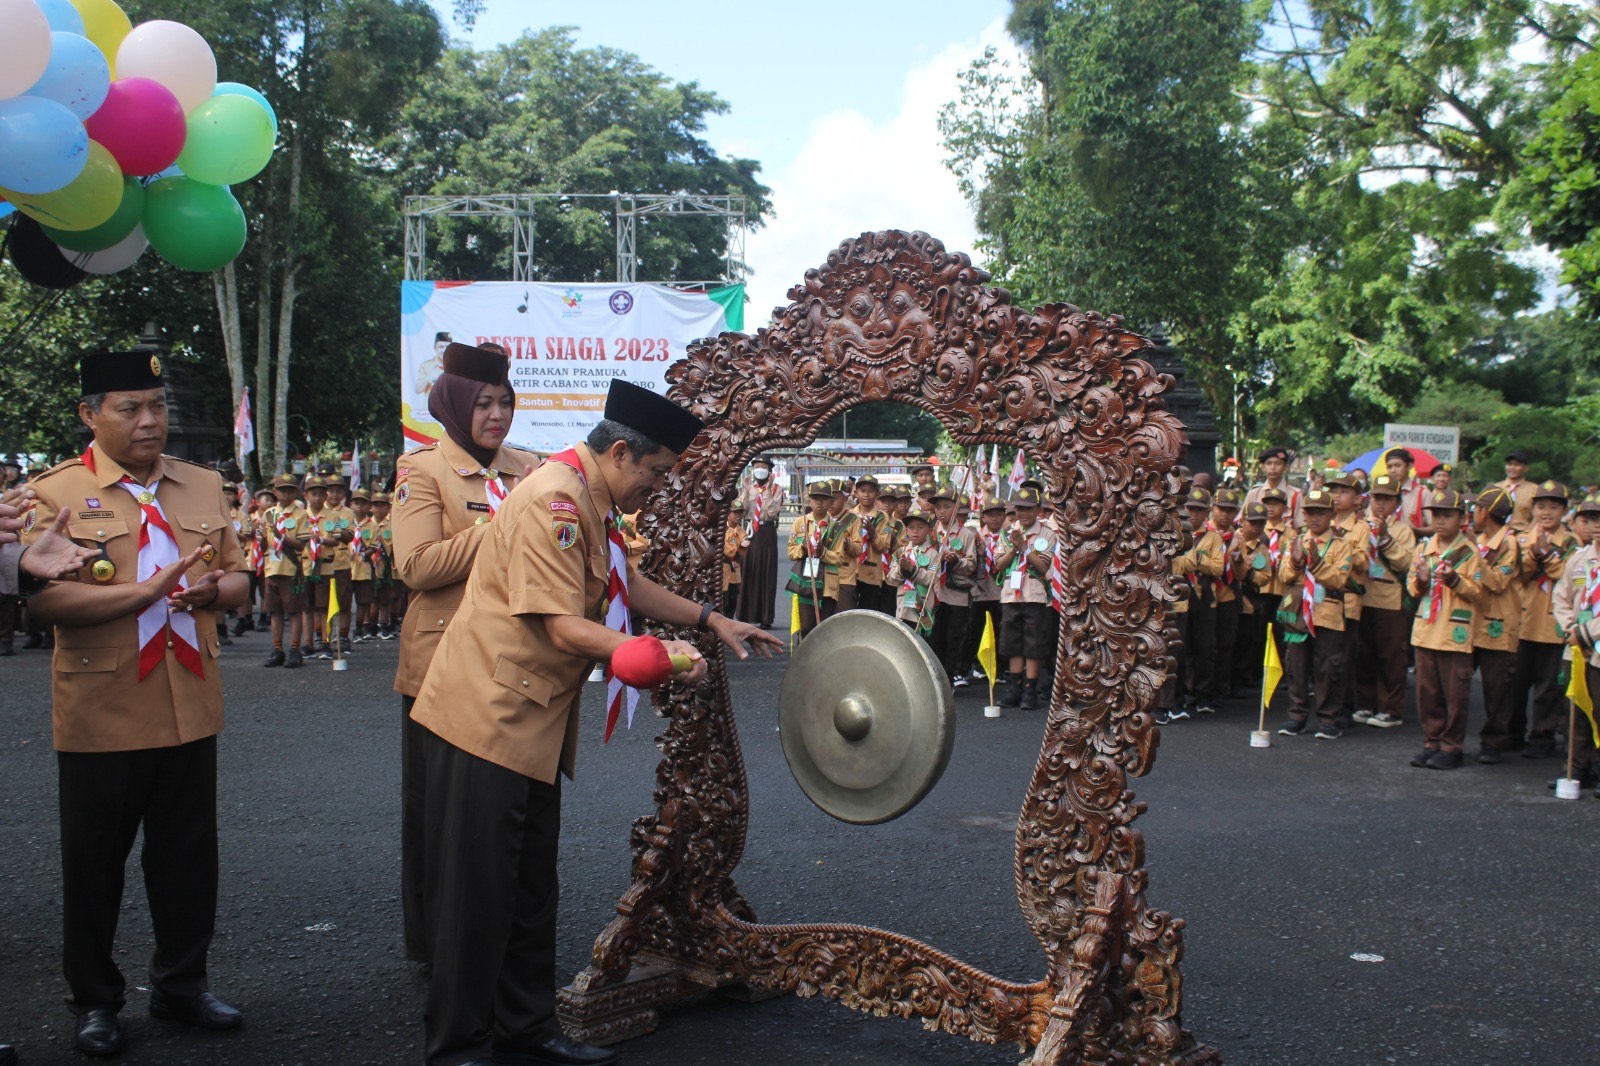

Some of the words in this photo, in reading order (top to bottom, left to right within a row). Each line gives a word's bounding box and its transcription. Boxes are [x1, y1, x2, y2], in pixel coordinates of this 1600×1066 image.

[545, 336, 607, 360] SIAGA
[614, 338, 670, 362] 2023
[516, 367, 569, 376] GERAKAN
[573, 367, 627, 377] PRAMUKA
[511, 379, 540, 388] RTIR
[543, 379, 588, 388] CABANG
[592, 380, 656, 390] WOOBO
[519, 397, 553, 407] Santun
[561, 398, 601, 407] Inovatif
